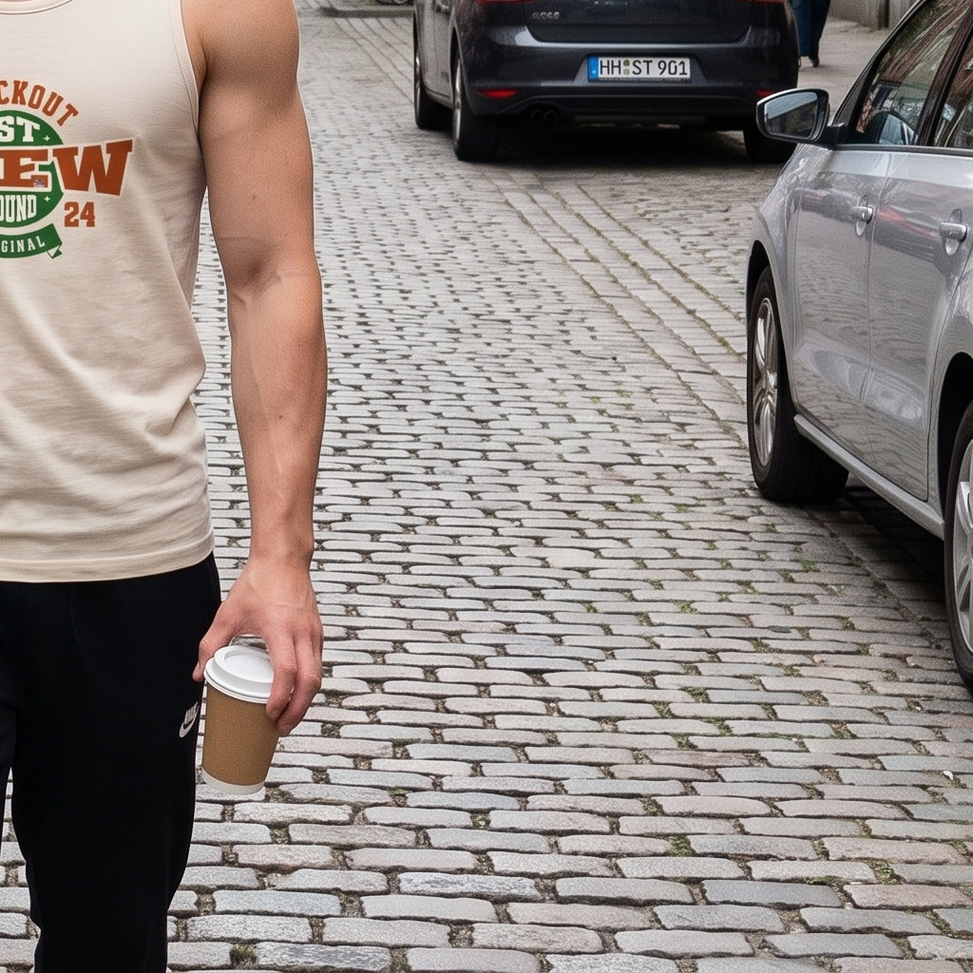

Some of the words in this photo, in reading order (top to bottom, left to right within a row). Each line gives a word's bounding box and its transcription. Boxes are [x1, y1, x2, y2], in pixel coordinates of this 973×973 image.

[600, 60, 621, 75] HH
[632, 60, 653, 75] ST
[64, 201, 95, 227] 24
